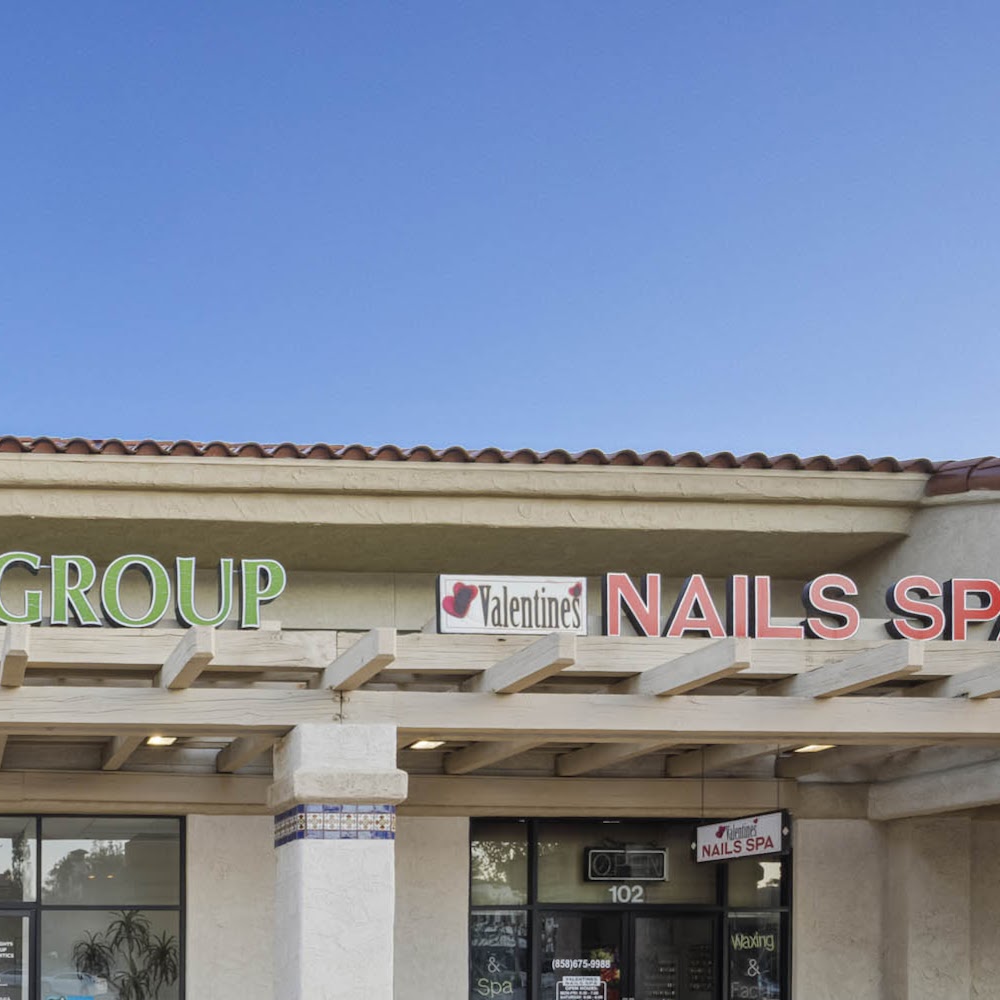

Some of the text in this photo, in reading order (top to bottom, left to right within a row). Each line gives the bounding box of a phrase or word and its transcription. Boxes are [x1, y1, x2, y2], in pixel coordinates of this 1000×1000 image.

[605, 572, 1000, 641] NAILS SP
[702, 835, 775, 858] NAILS SPA
[608, 885, 645, 904] 102
[731, 931, 775, 952] Waxing
[487, 956, 501, 973] &
[552, 959, 611, 970] (858)675-9988
[747, 958, 761, 977] &
[477, 977, 514, 998] Spa
